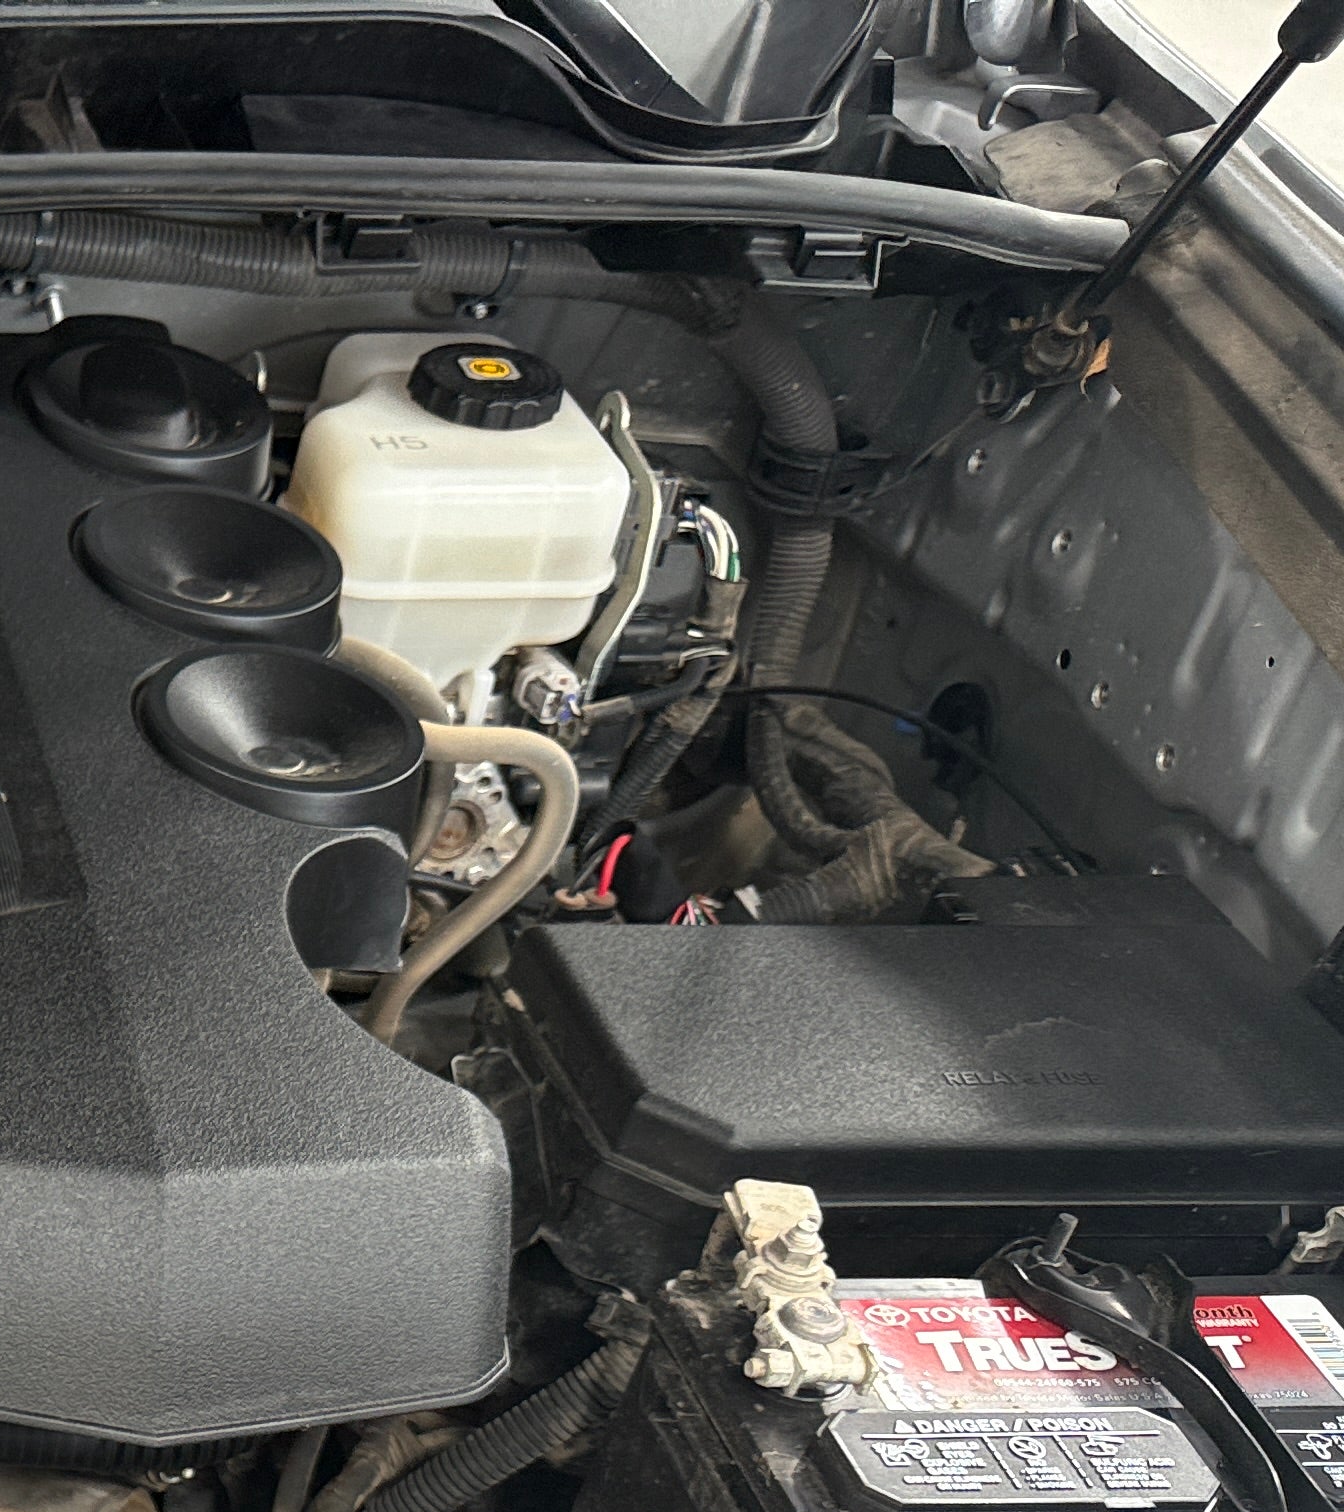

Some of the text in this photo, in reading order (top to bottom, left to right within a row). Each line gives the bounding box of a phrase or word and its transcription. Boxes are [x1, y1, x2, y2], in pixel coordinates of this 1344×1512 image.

[942, 1070, 1018, 1088] RELAY
[1041, 1071, 1105, 1088] FUSE
[910, 1306, 1037, 1323] TOYOTA
[1196, 1318, 1259, 1328] WARRANTY
[913, 1418, 1009, 1433] DANGER
[1029, 1417, 1114, 1431] POISON
